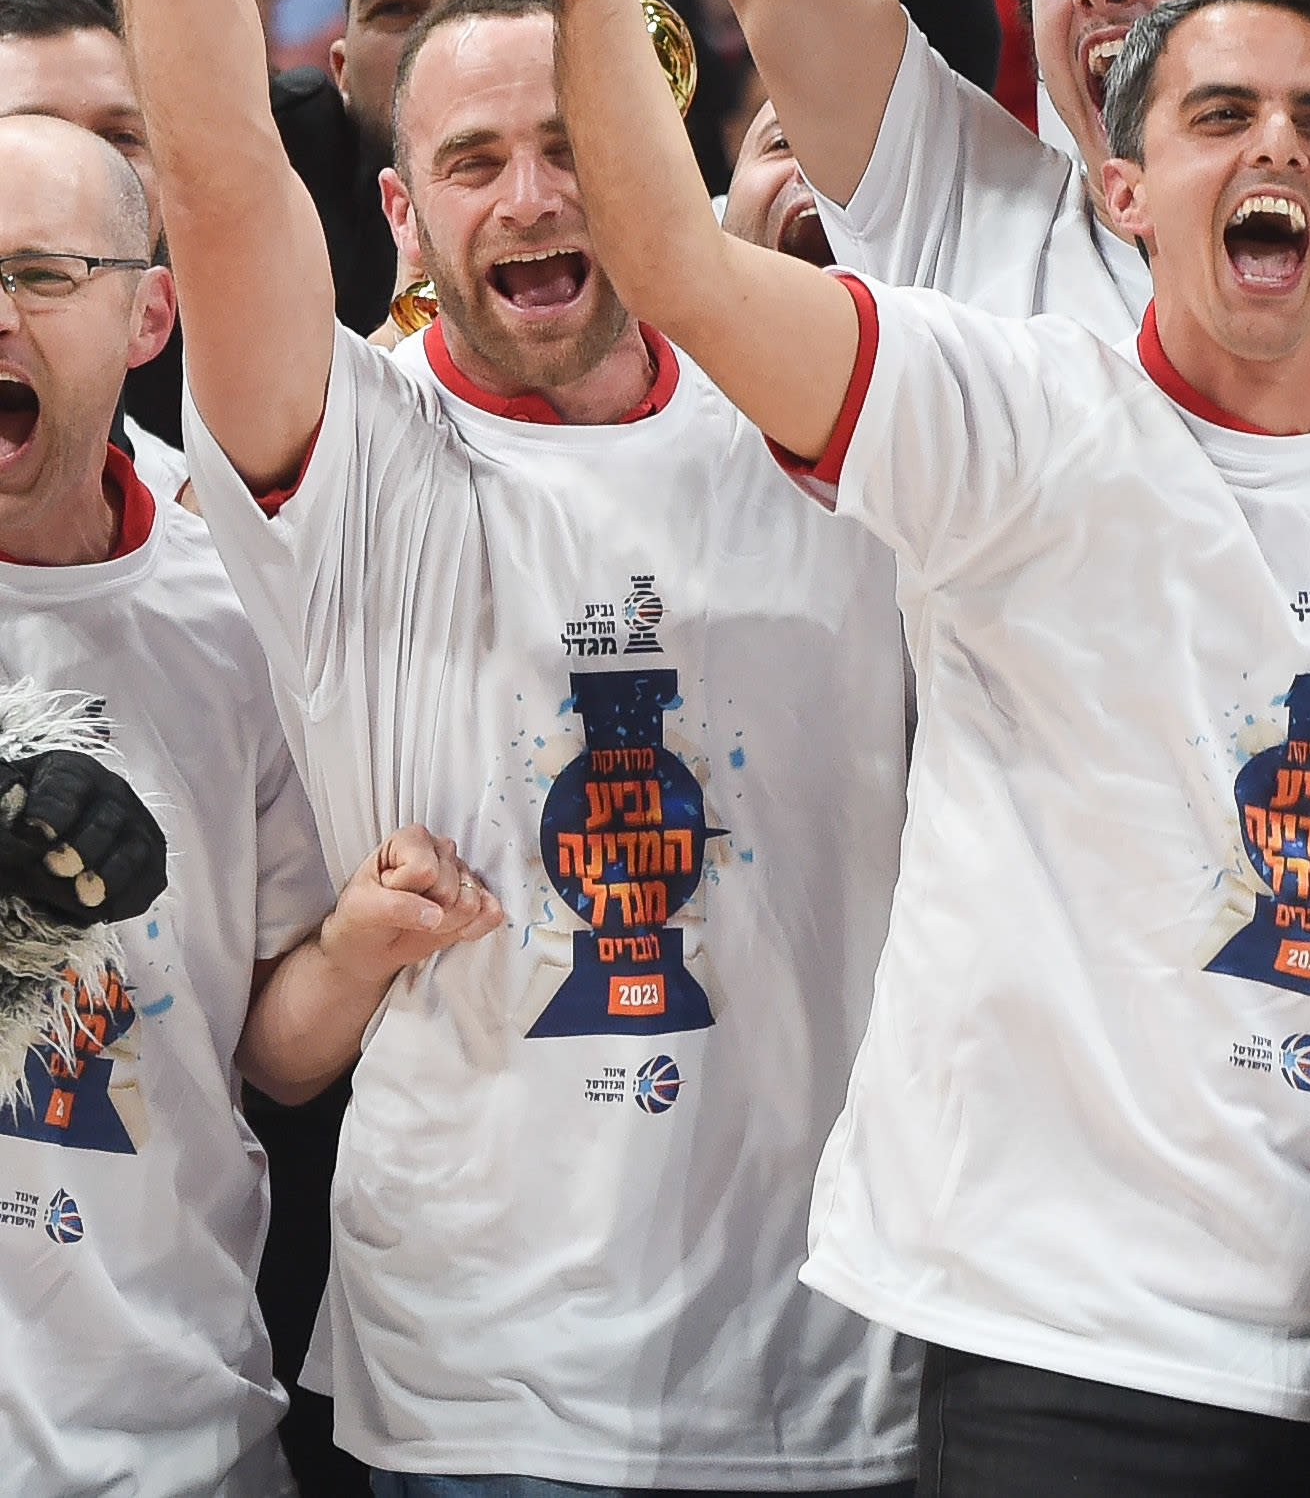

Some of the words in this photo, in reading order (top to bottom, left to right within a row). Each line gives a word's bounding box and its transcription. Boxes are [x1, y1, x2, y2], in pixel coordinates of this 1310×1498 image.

[584, 604, 615, 620] גביע
[565, 620, 616, 636] המדינה
[560, 633, 618, 657] מגדל
[591, 748, 655, 774] מחזיקת
[585, 780, 662, 829] גביע
[557, 829, 693, 879] המדינה
[582, 877, 668, 927] מגדל
[618, 984, 659, 1007] 2023
[0, 1201, 37, 1218] הכדורס
[15, 1190, 39, 1206] איגוד
[0, 1213, 36, 1229] הישרא
